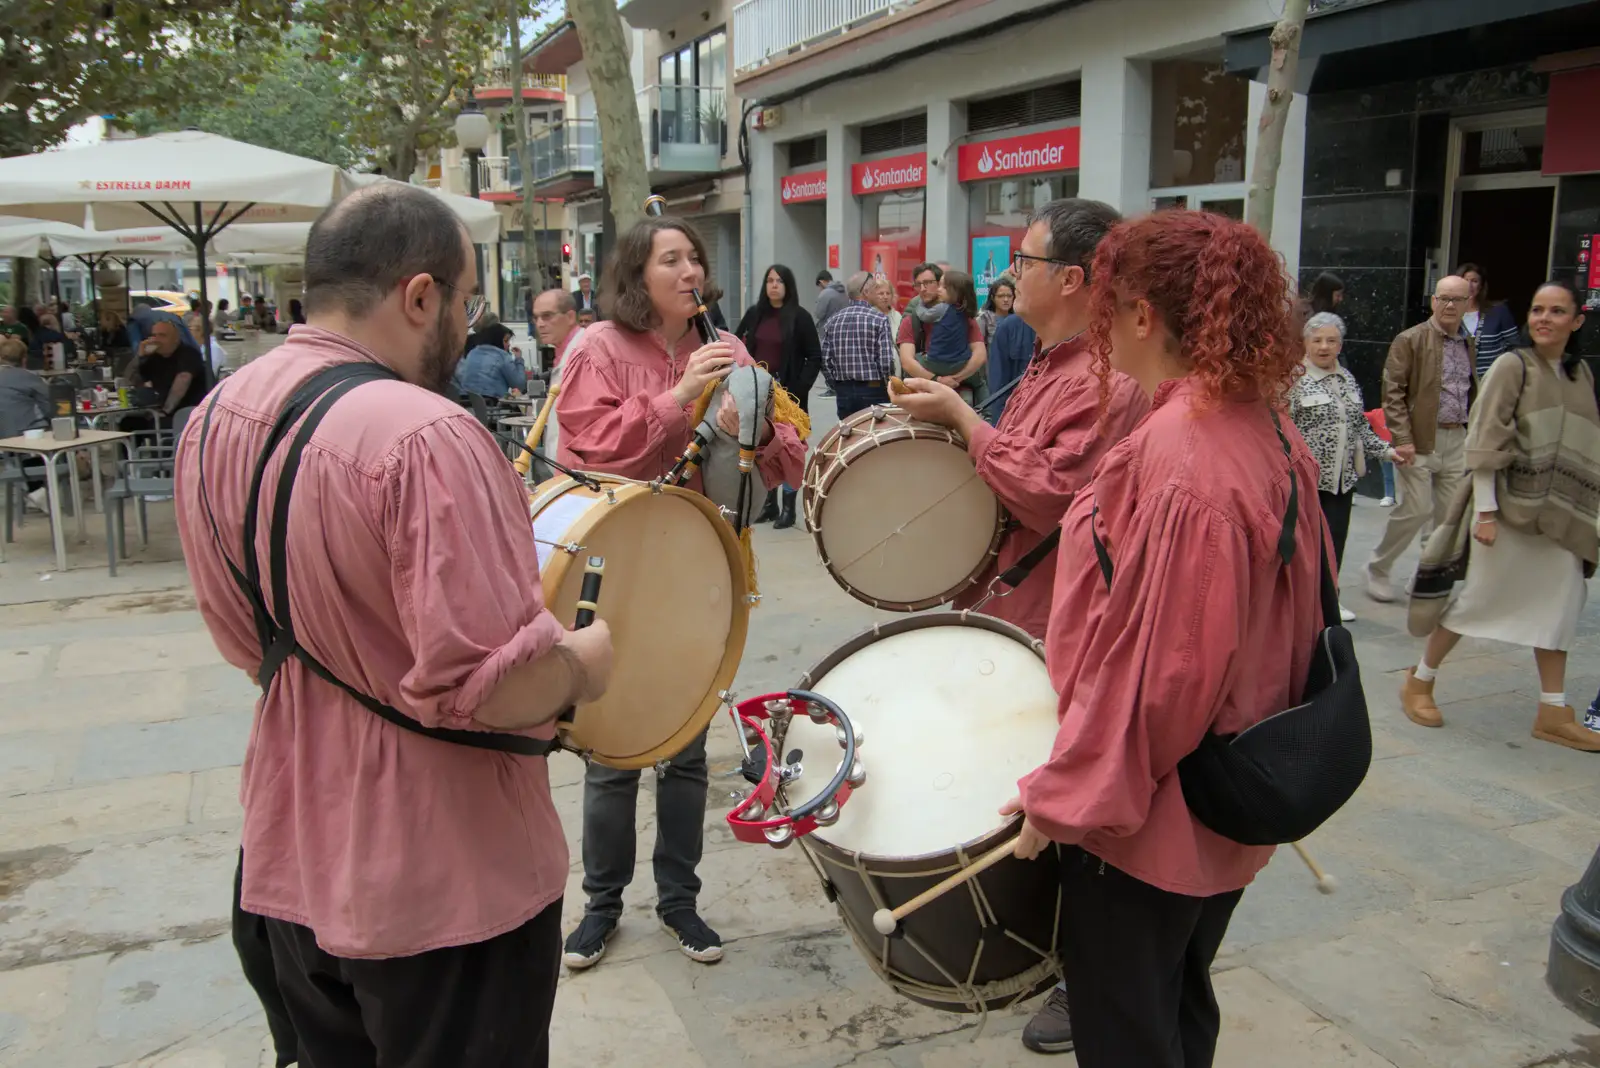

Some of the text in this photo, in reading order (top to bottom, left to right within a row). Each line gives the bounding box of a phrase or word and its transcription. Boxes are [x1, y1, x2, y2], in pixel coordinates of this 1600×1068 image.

[994, 142, 1065, 171] Santander
[96, 180, 191, 191] ESTRELLA DAMM
[873, 163, 924, 188] Santander
[791, 179, 827, 199] Santande
